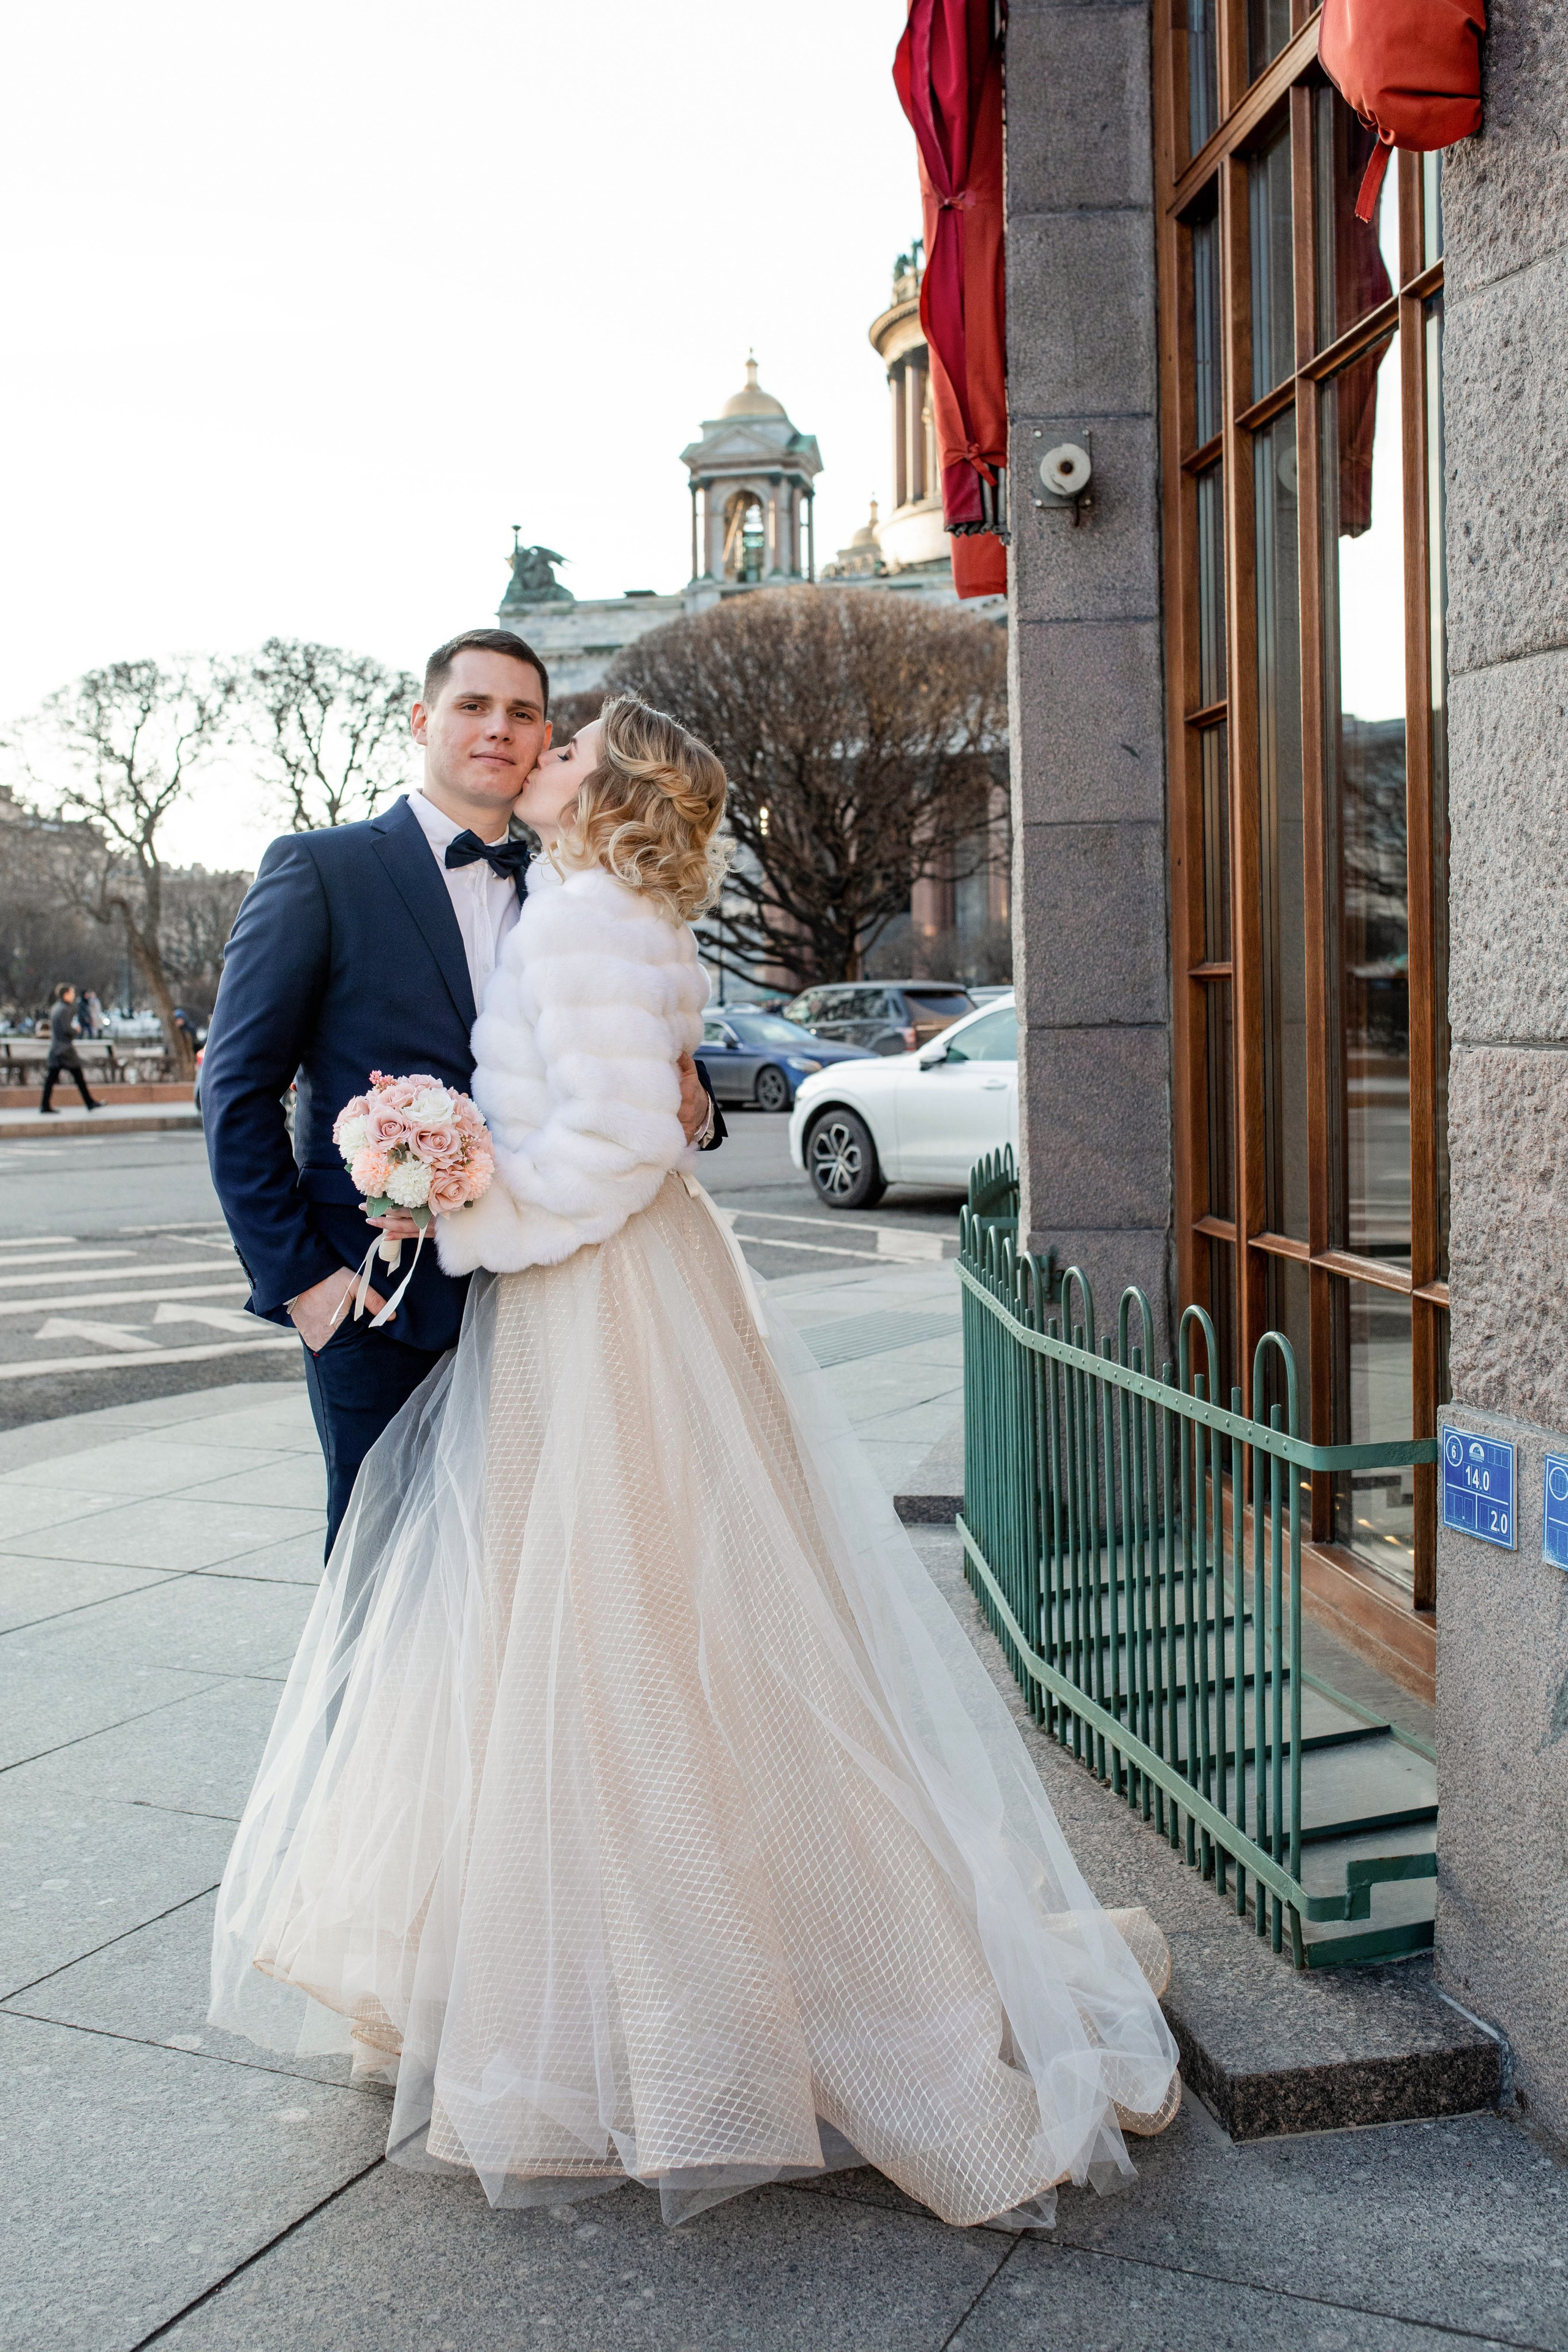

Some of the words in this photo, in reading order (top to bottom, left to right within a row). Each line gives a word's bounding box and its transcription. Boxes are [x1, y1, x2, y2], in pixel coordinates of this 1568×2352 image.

[1452, 1445, 1457, 1458] 6
[1465, 1465, 1490, 1491] 14.0
[1490, 1510, 1508, 1534] 2.0
